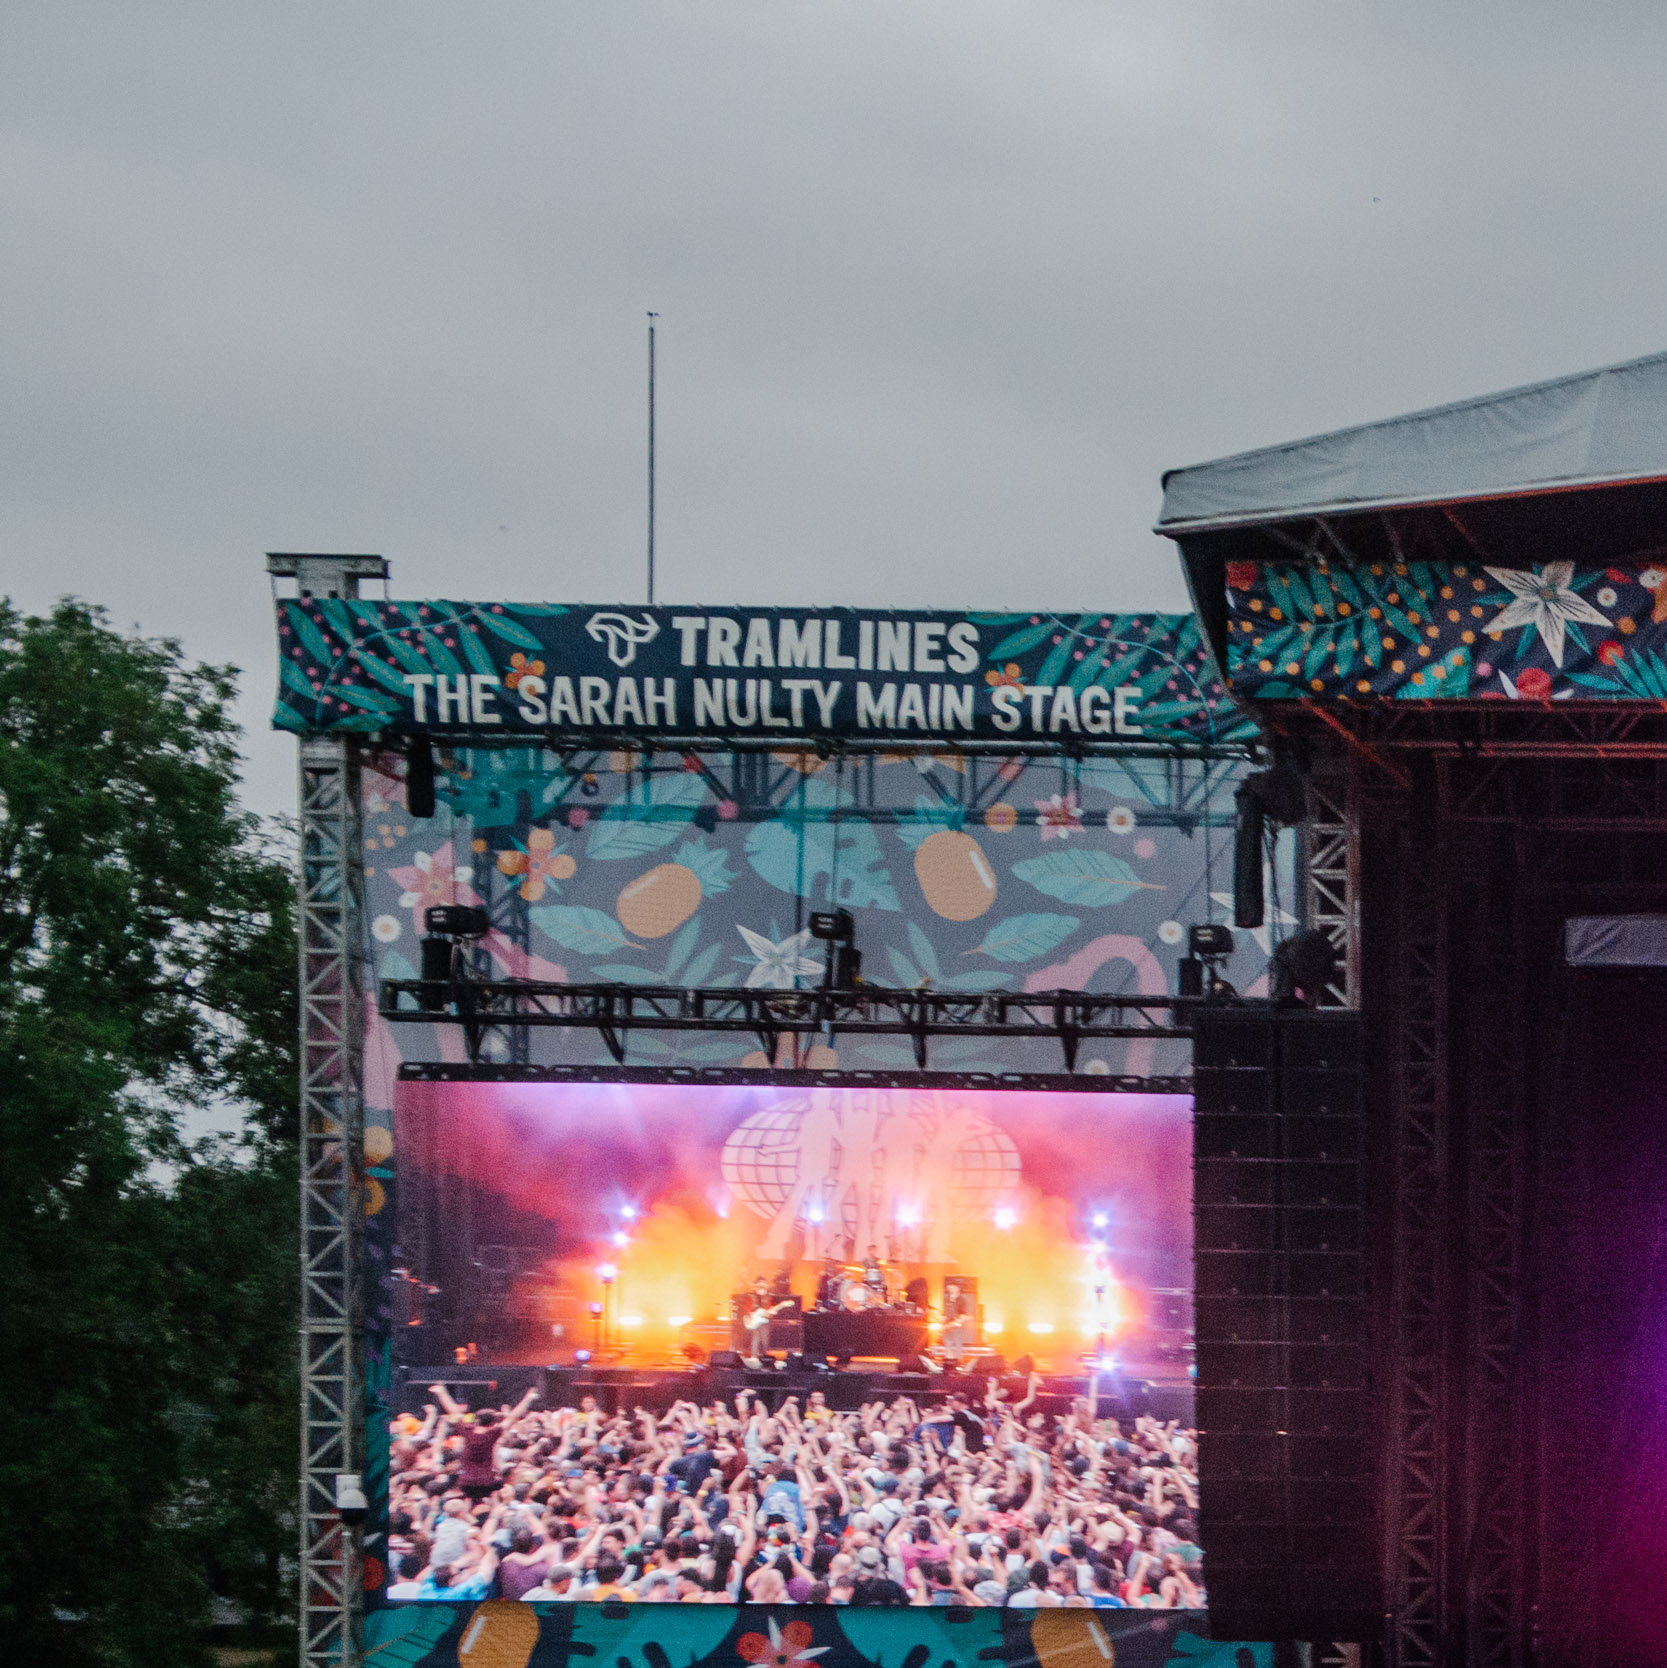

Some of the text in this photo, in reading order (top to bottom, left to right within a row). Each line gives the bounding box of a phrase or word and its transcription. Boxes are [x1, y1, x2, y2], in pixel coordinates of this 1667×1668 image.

[672, 615, 980, 674] TRAMLINES
[403, 673, 1143, 735] THE SARAH NULTY MAIN STAGE
